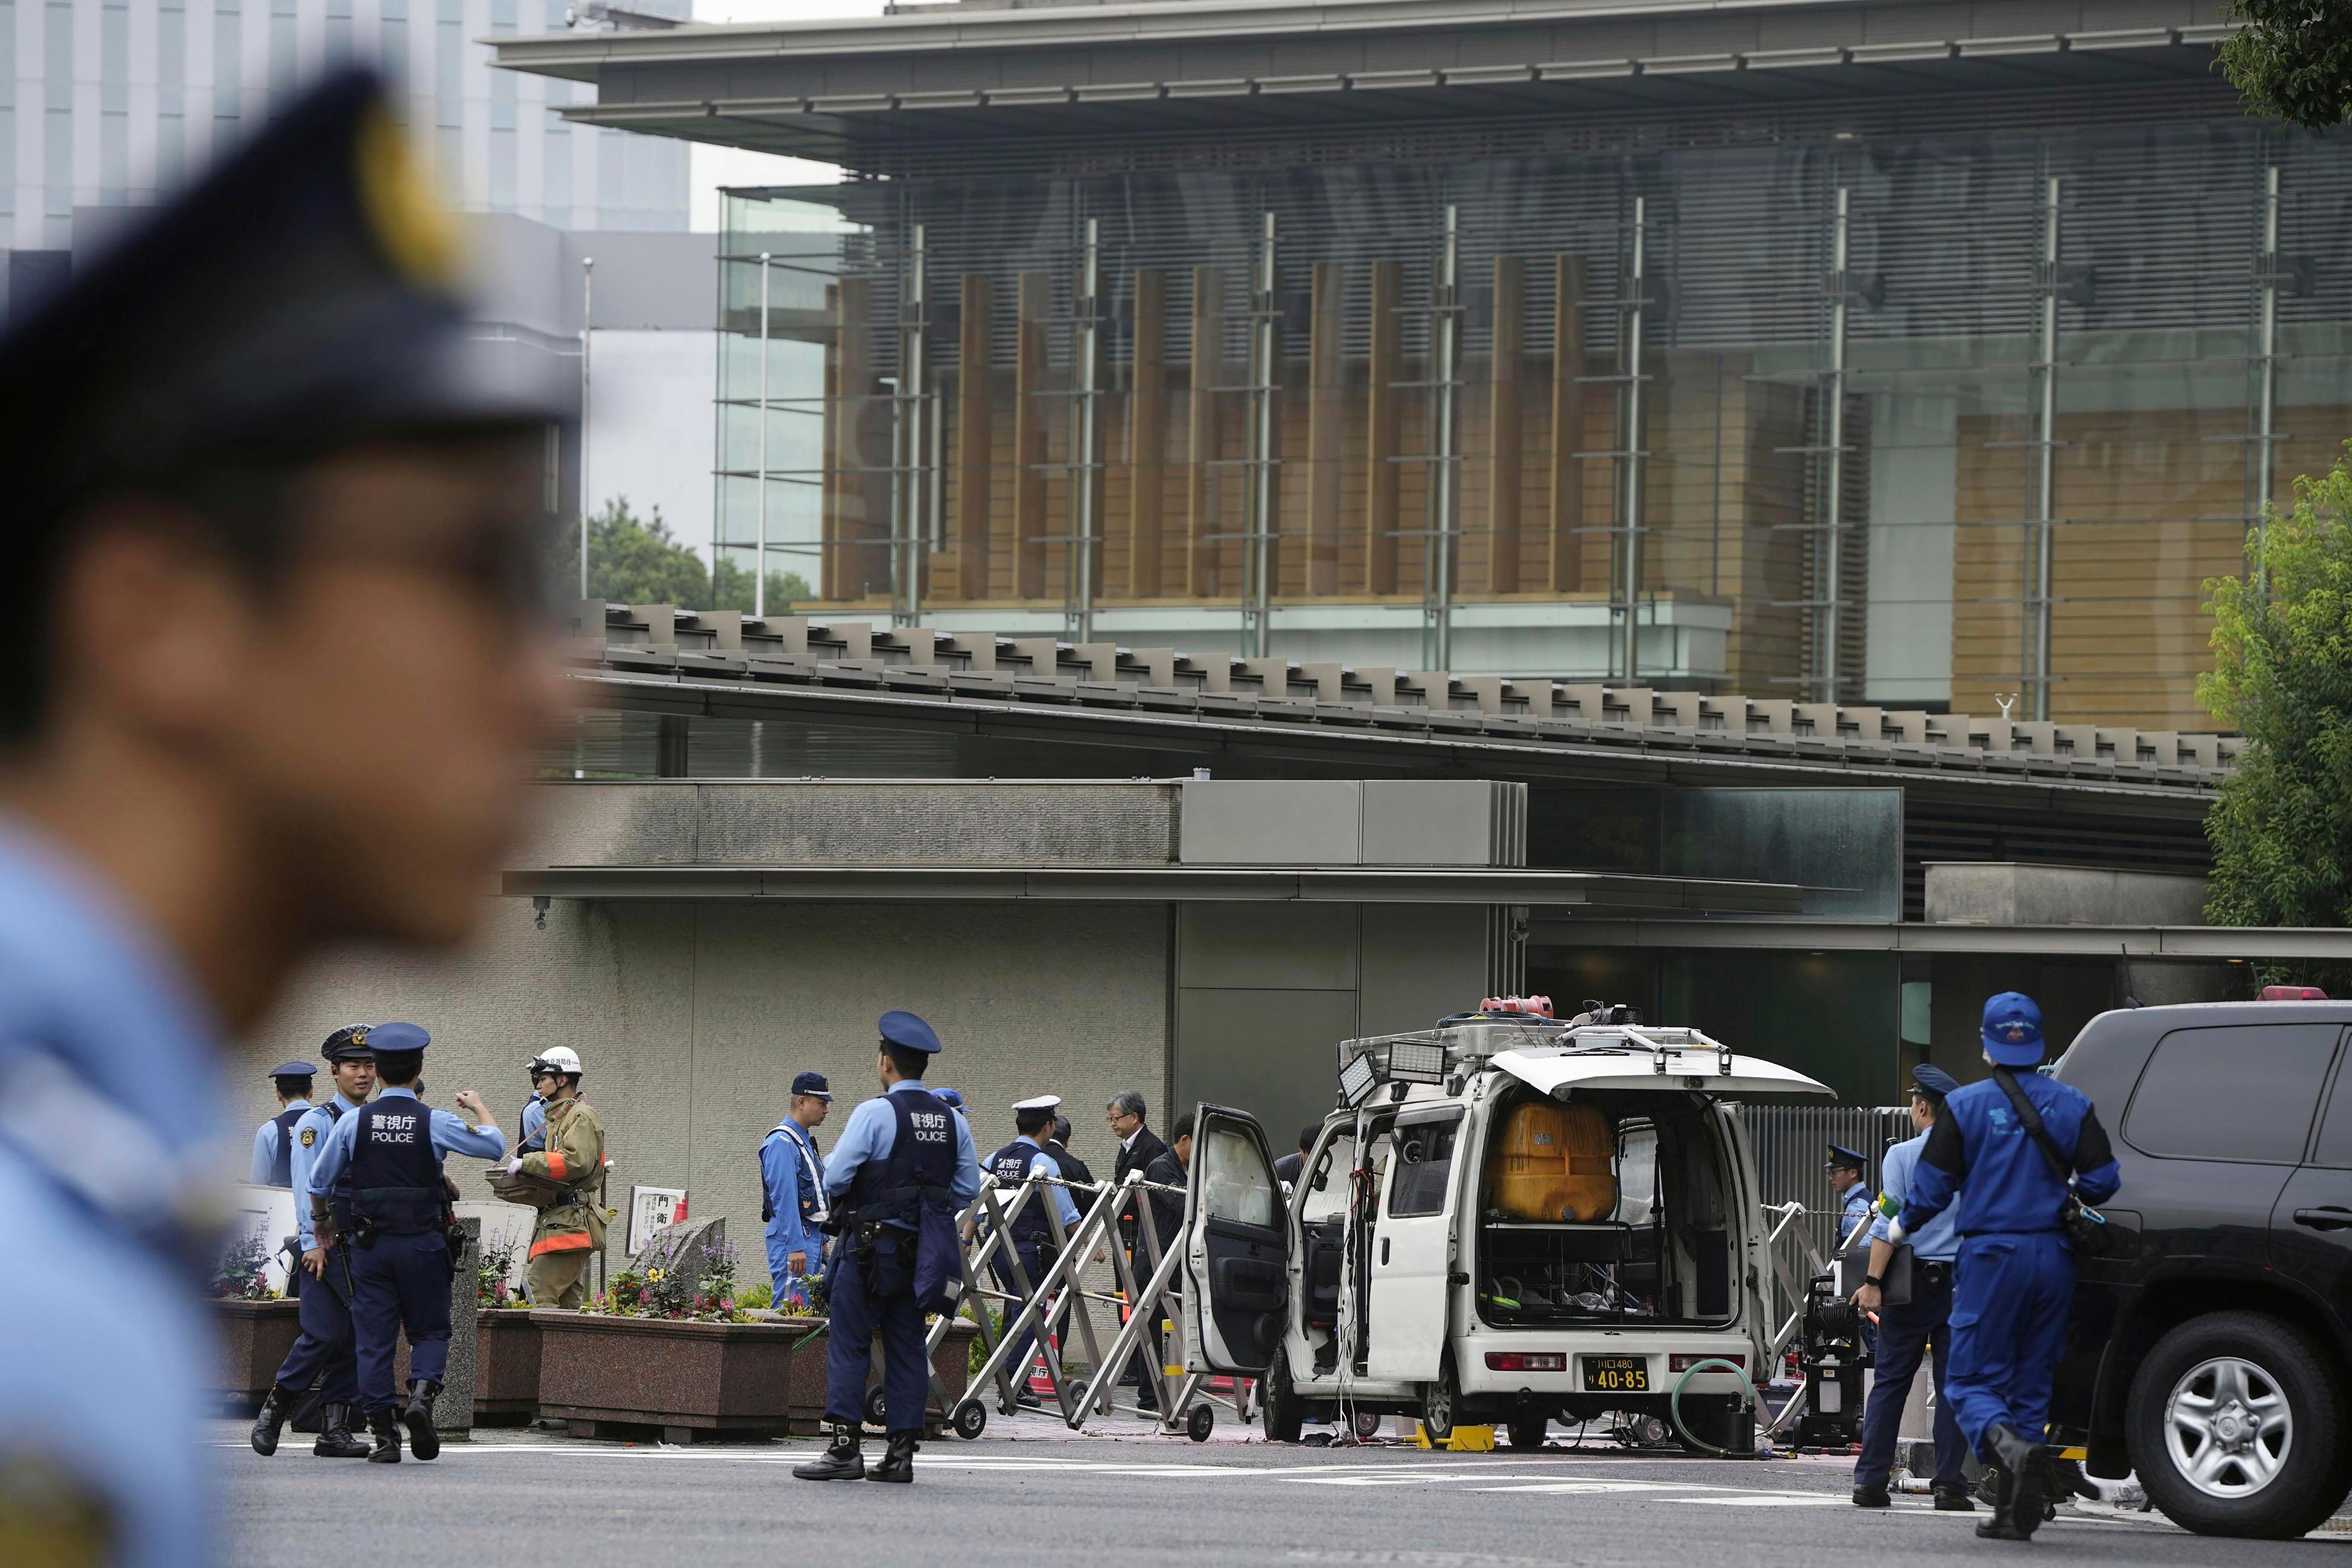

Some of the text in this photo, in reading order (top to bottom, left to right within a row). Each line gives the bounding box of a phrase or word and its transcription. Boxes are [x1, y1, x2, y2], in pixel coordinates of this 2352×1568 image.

[372, 1114, 416, 1130] 警視庁
[372, 1131, 414, 1142] POLICE
[656, 1196, 668, 1224] 門衛
[1597, 1360, 1633, 1369] 川口 480
[1598, 1370, 1645, 1388] 40-85
